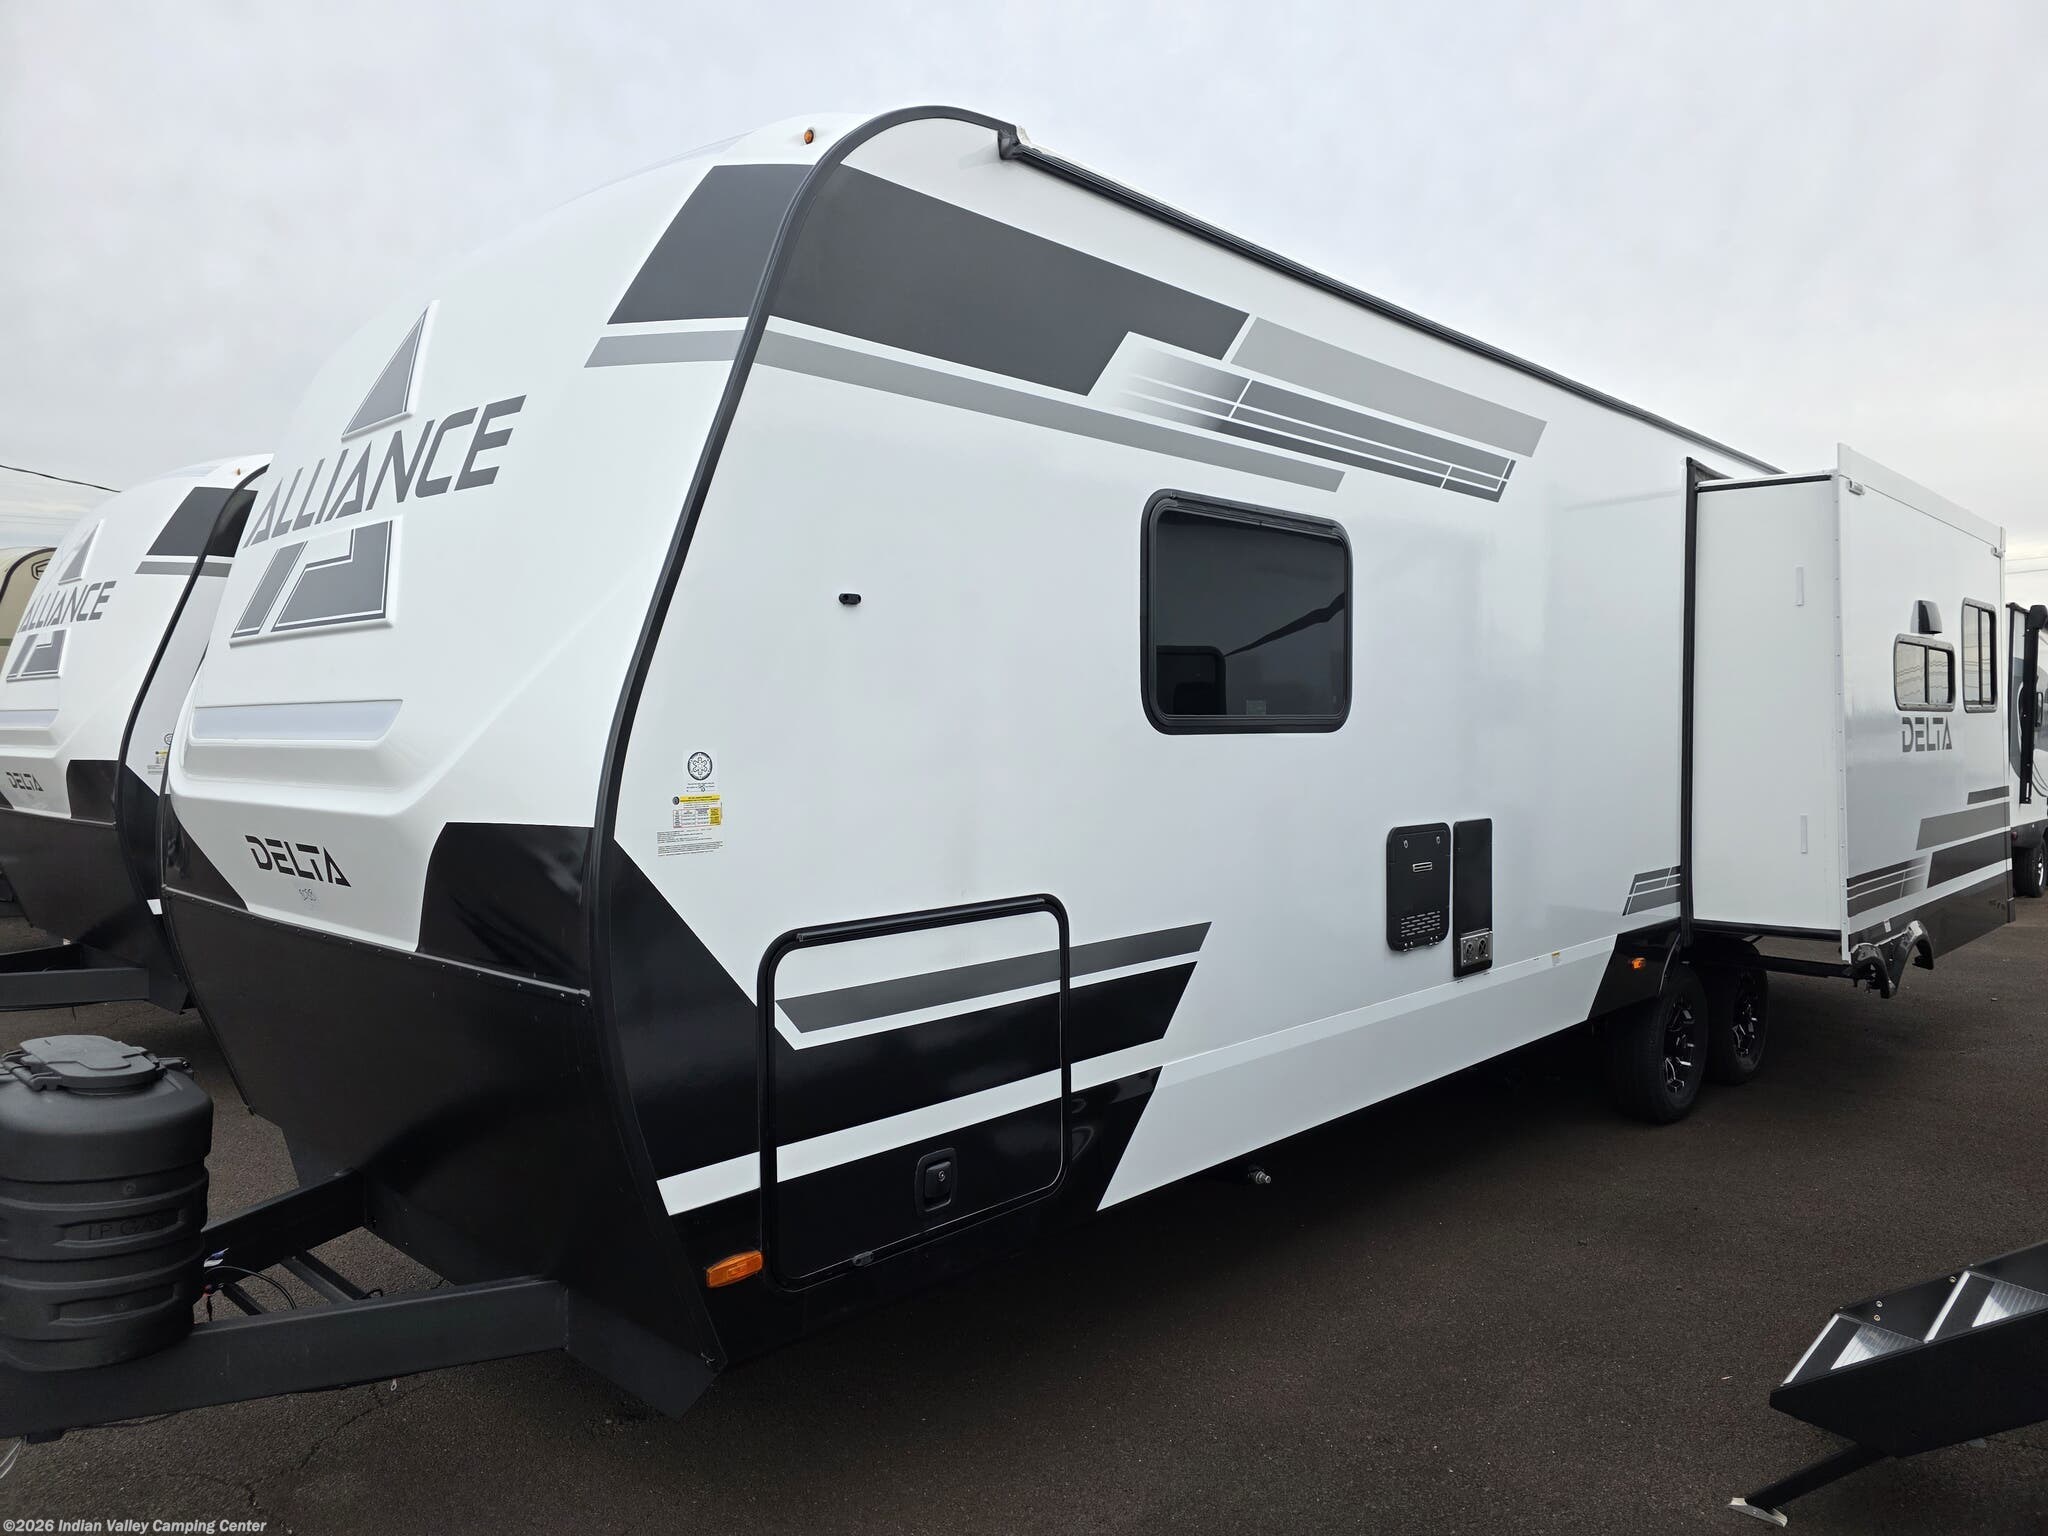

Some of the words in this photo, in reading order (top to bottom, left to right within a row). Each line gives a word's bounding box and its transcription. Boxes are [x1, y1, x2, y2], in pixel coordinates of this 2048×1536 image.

[244, 394, 526, 548] ALLIANCE
[17, 580, 117, 634] ALLIANCE
[1902, 716, 1953, 752] DELTA
[6, 771, 44, 792] DELTA
[245, 835, 352, 888] DELTA
